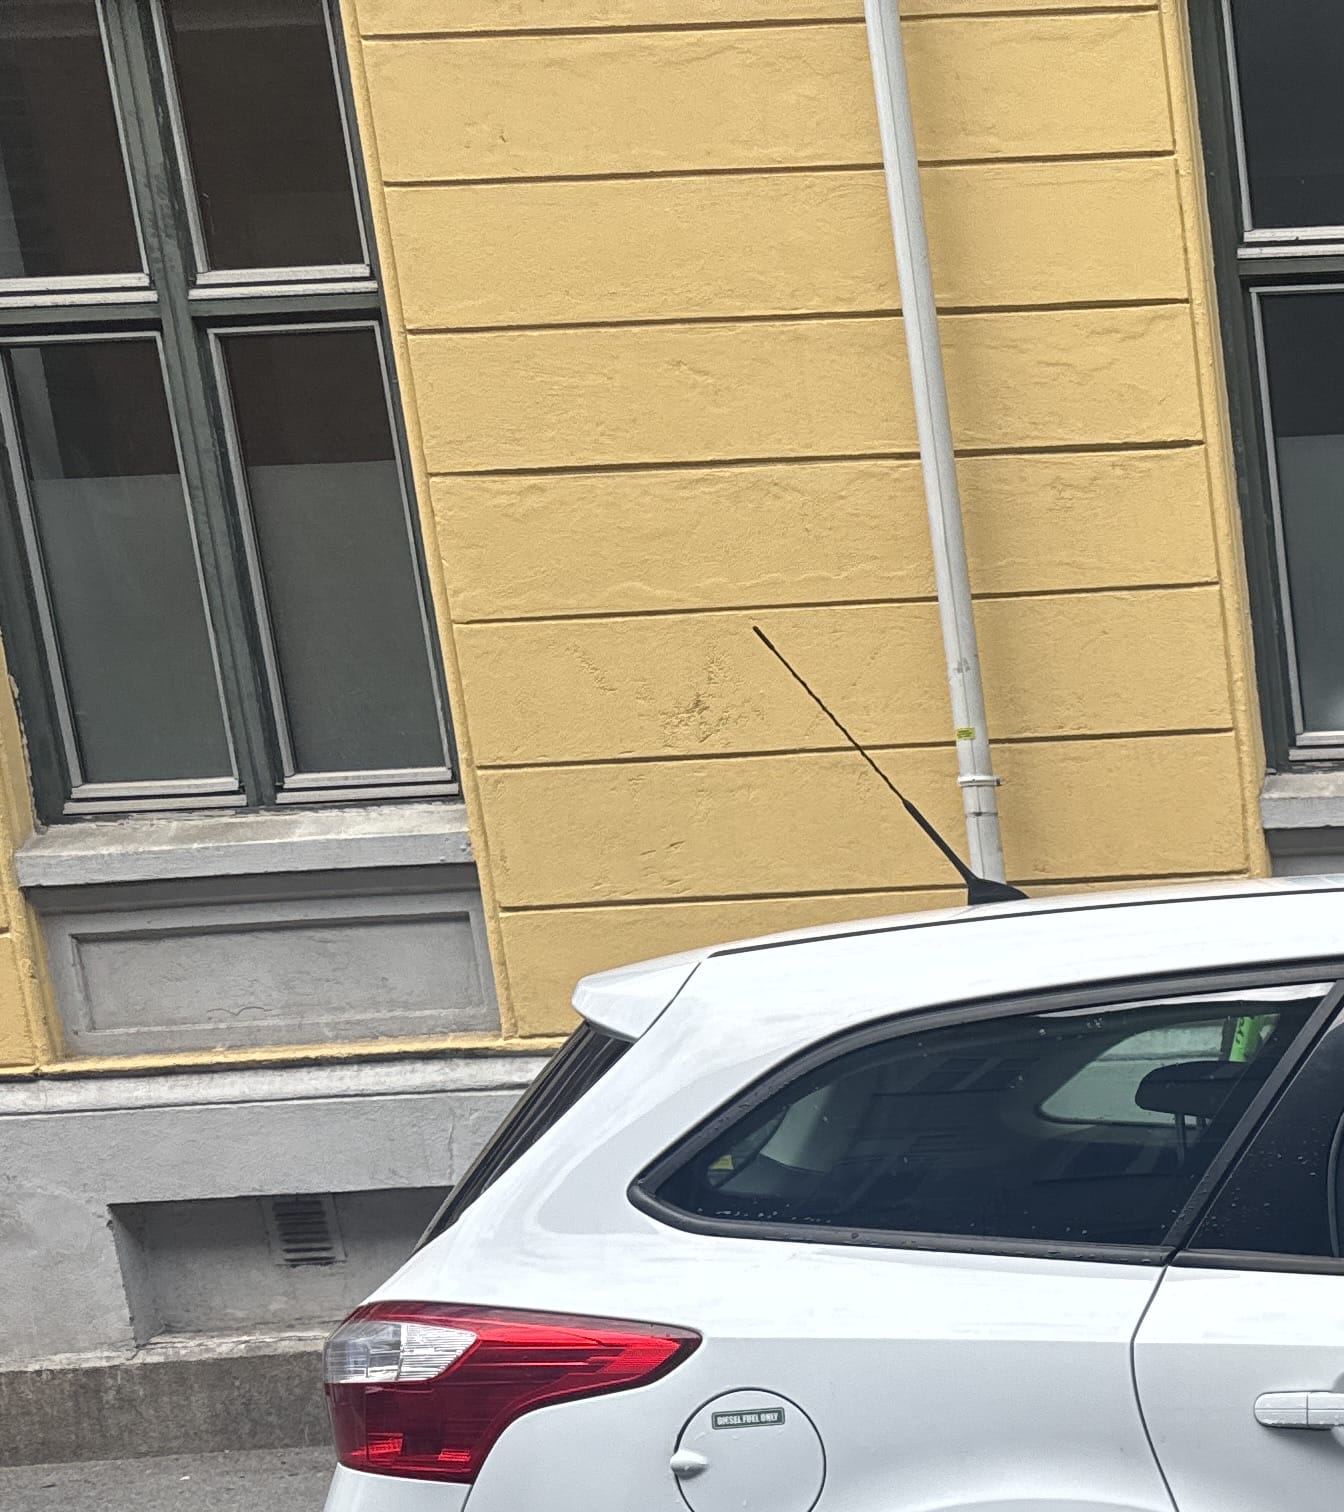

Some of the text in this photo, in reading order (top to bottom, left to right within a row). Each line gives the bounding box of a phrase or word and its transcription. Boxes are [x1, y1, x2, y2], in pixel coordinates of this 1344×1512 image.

[717, 1412, 779, 1425] DIESEL FUEL ONLY
